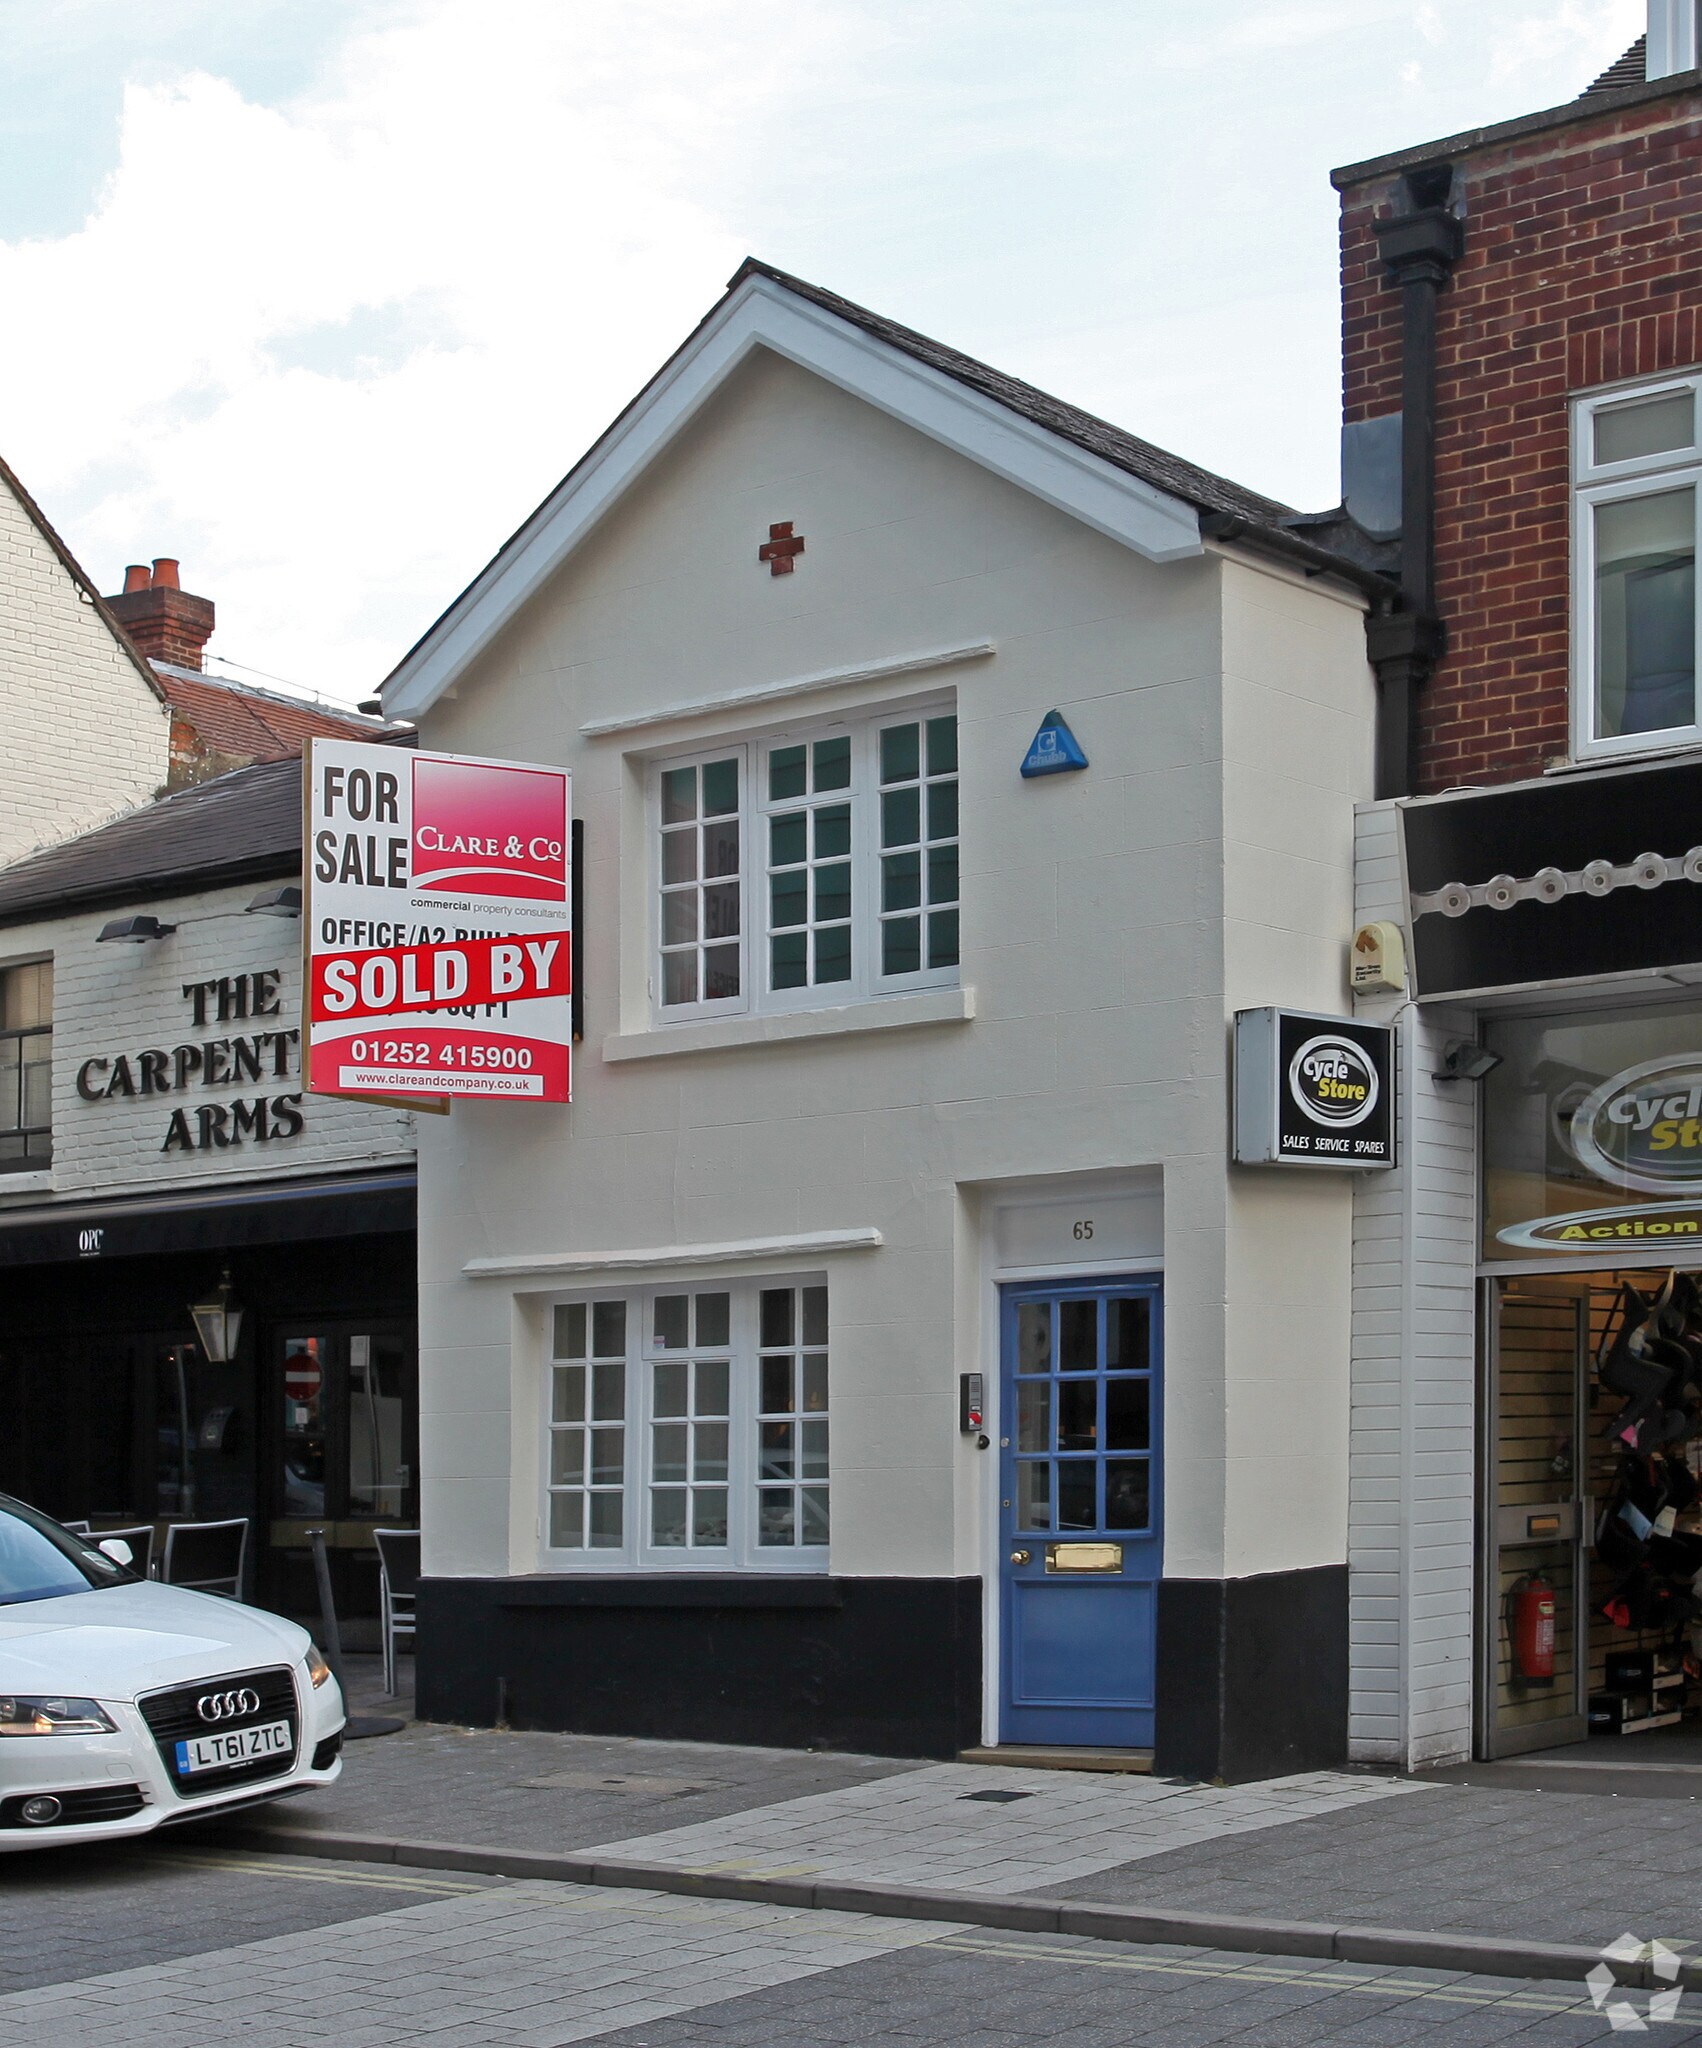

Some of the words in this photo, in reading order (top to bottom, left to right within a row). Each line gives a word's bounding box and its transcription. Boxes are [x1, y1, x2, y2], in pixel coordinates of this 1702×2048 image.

[323, 766, 400, 824] FOR
[315, 830, 408, 889] SALE
[503, 835, 525, 859] &
[410, 898, 472, 911] commercial
[473, 903, 513, 916] property
[514, 906, 567, 920] consultants
[322, 949, 469, 1013] SOLD
[490, 939, 560, 995] BY
[182, 968, 280, 1026] THE
[76, 1028, 300, 1101] CARPENT
[351, 1039, 430, 1064] 01252
[438, 1044, 533, 1069] 415900
[1303, 1056, 1349, 1082] Cycle
[355, 1072, 530, 1090] www.clareandcompany.co.uk
[1318, 1077, 1366, 1101] Store
[160, 1092, 304, 1153] ARMS
[1607, 1086, 1702, 1131] Cycl
[1282, 1134, 1310, 1149] SALES
[1314, 1137, 1350, 1152] SERVICE
[1354, 1140, 1385, 1154] SPARES
[1649, 1118, 1702, 1150] St
[1072, 1220, 1094, 1241] 65
[1558, 1220, 1698, 1240] Action
[196, 1734, 245, 1765] LT61
[248, 1725, 286, 1754] ZTC
